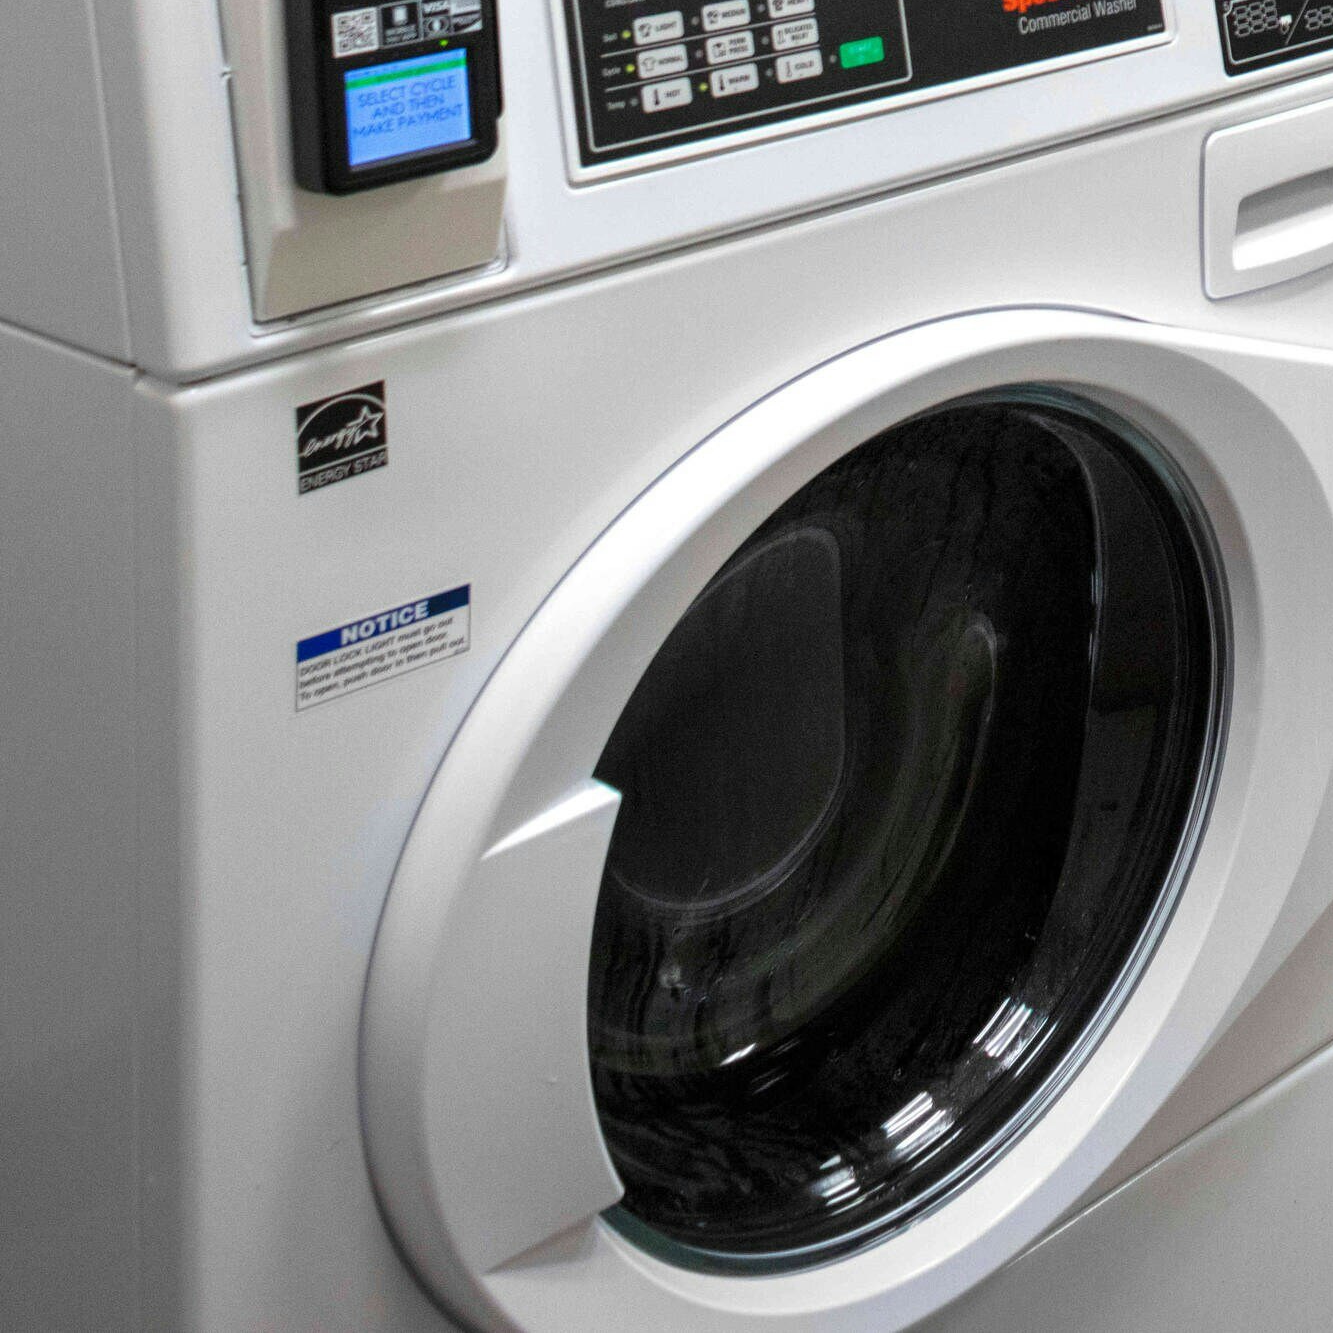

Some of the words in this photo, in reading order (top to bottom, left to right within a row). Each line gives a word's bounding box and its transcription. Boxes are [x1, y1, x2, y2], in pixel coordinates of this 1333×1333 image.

[1018, 3, 1092, 35] Commercial
[358, 85, 405, 108] SELECT
[410, 74, 456, 96] CYCLE
[372, 101, 406, 120] AND
[409, 94, 445, 110] THEN
[352, 118, 394, 137] MAKE
[397, 103, 463, 127] PAYMENT
[300, 462, 352, 492] ENERGY
[354, 450, 387, 474] STAR
[340, 600, 430, 646] NOTICE
[300, 658, 332, 677] DOOR
[334, 648, 362, 665] LOCK
[366, 636, 396, 654] LIGHT
[398, 628, 422, 642] must
[424, 623, 436, 635] go
[436, 617, 454, 630] out
[300, 672, 331, 689] before
[334, 654, 386, 678] attempting
[388, 650, 398, 658] to
[400, 642, 422, 654] open
[300, 691, 312, 700] To
[344, 671, 368, 687] push
[370, 664, 392, 677] door
[396, 658, 404, 667] in
[406, 650, 428, 664] then
[430, 644, 446, 658] pull
